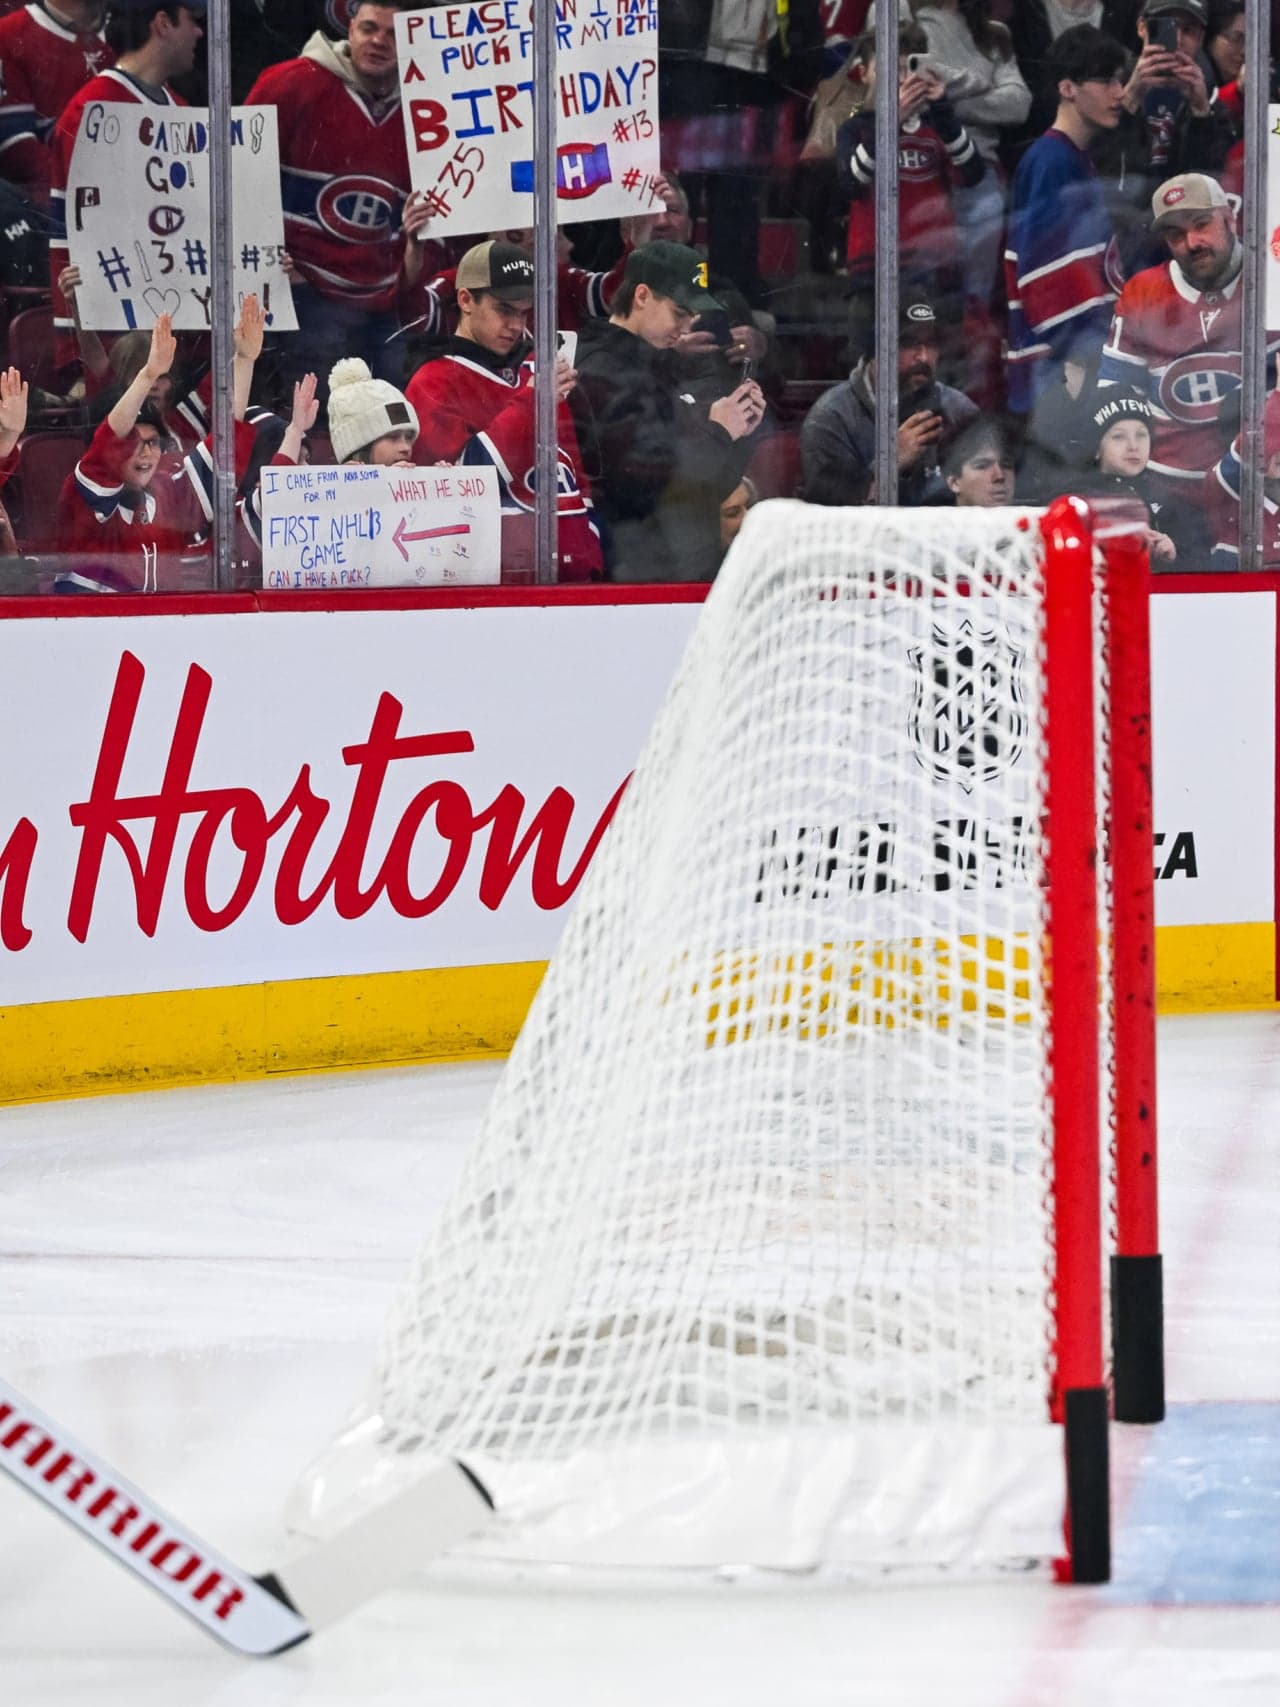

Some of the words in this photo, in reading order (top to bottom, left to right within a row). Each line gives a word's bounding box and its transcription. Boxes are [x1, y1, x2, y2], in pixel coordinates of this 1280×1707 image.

[407, 1, 521, 44] PLEASE
[403, 58, 425, 84] A
[441, 34, 511, 74] PUCK
[519, 24, 573, 58] FR
[581, 18, 612, 46] MY
[86, 104, 120, 144] GO
[139, 112, 264, 155] CANADNS
[612, 110, 653, 143] #13
[145, 156, 195, 194] GO!
[424, 142, 485, 218] #35
[265, 473, 279, 494] I
[286, 473, 313, 490] CAME
[303, 491, 320, 503] FOR
[325, 488, 336, 501] MY
[388, 479, 427, 503] WHAT
[436, 479, 452, 499] HE
[459, 477, 486, 497] SAID
[270, 515, 320, 549] FIRST
[301, 542, 346, 570] GAME
[268, 569, 290, 588] CAN
[293, 571, 302, 588] I
[305, 571, 327, 587] HAVE
[330, 571, 338, 585] A
[67, 649, 634, 944] Horton
[0, 1405, 246, 1622] ARRIOR
